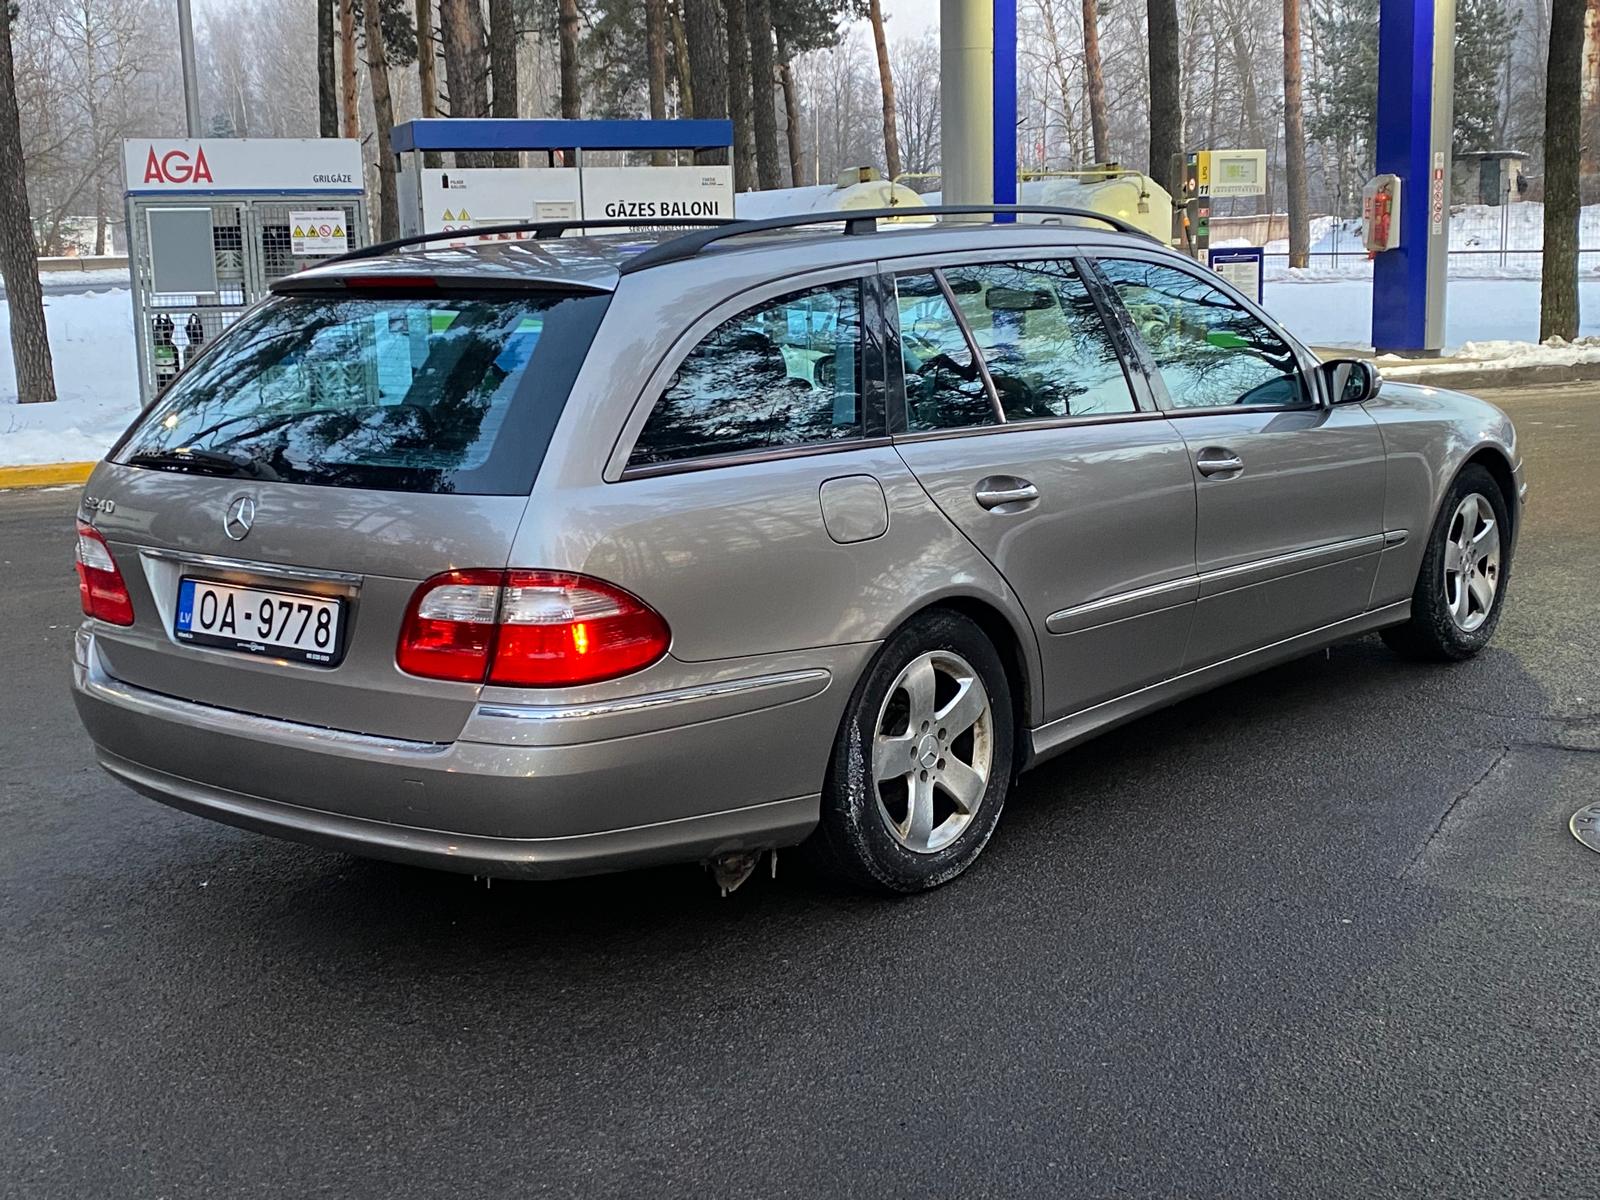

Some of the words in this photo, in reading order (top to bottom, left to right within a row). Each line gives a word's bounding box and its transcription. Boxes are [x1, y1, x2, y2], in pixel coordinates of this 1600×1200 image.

[144, 144, 213, 183] AGA
[1200, 185, 1209, 194] 11
[605, 199, 656, 217] GĀZES
[660, 201, 719, 216] BALONI
[179, 612, 192, 624] LV
[200, 590, 331, 648] OA-9778
